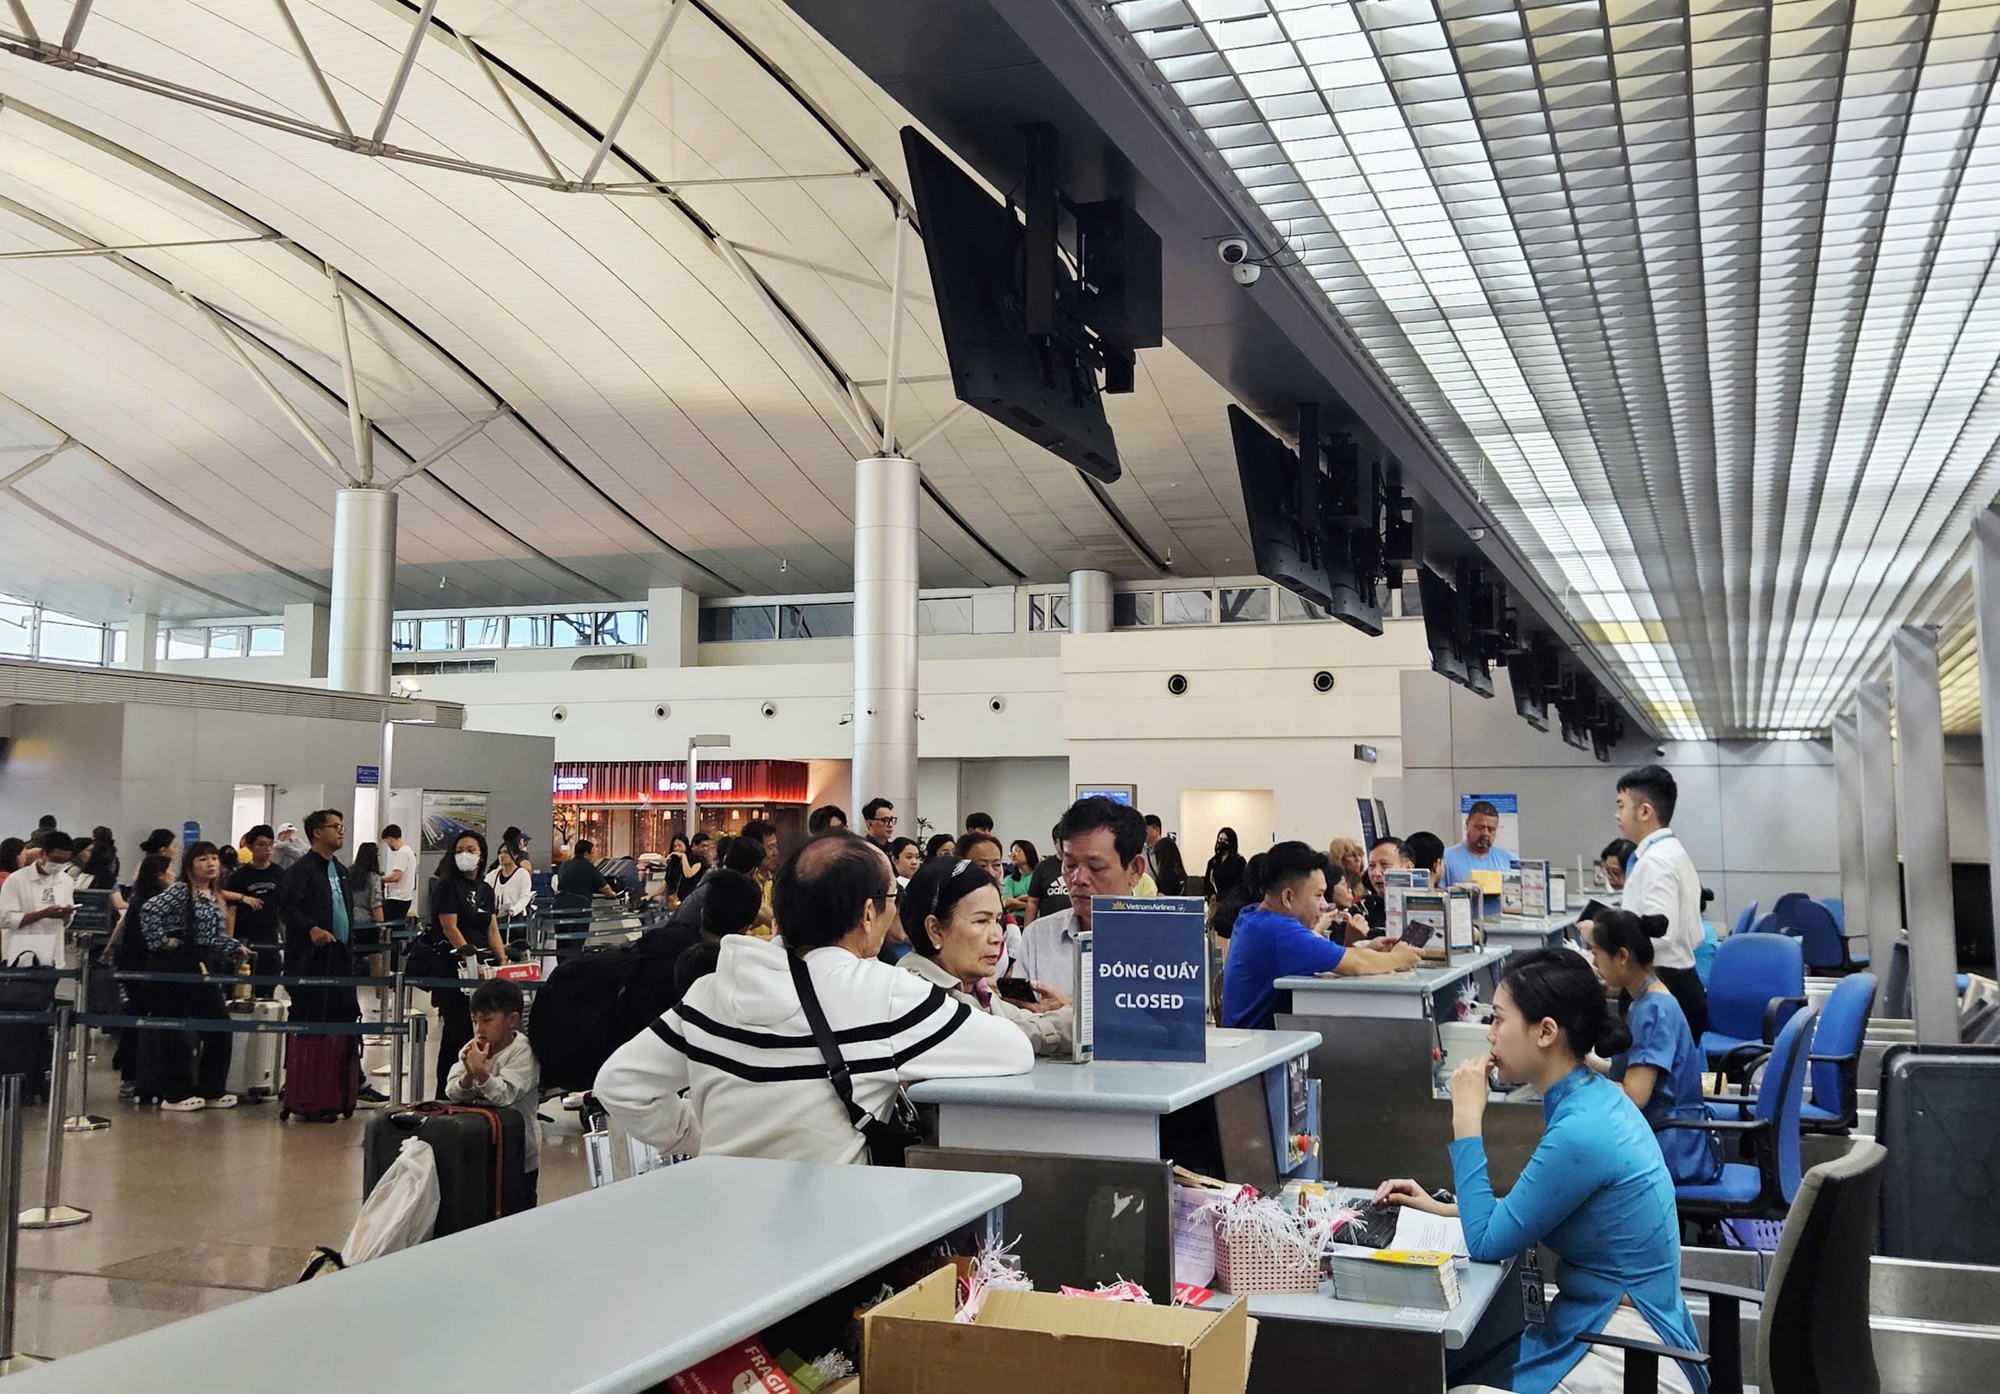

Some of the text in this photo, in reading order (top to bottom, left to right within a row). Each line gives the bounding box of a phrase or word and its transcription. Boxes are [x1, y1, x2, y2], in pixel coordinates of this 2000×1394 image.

[1098, 960, 1200, 981] ĐÓNG QUẦY
[1114, 993, 1184, 1010] CLOSED
